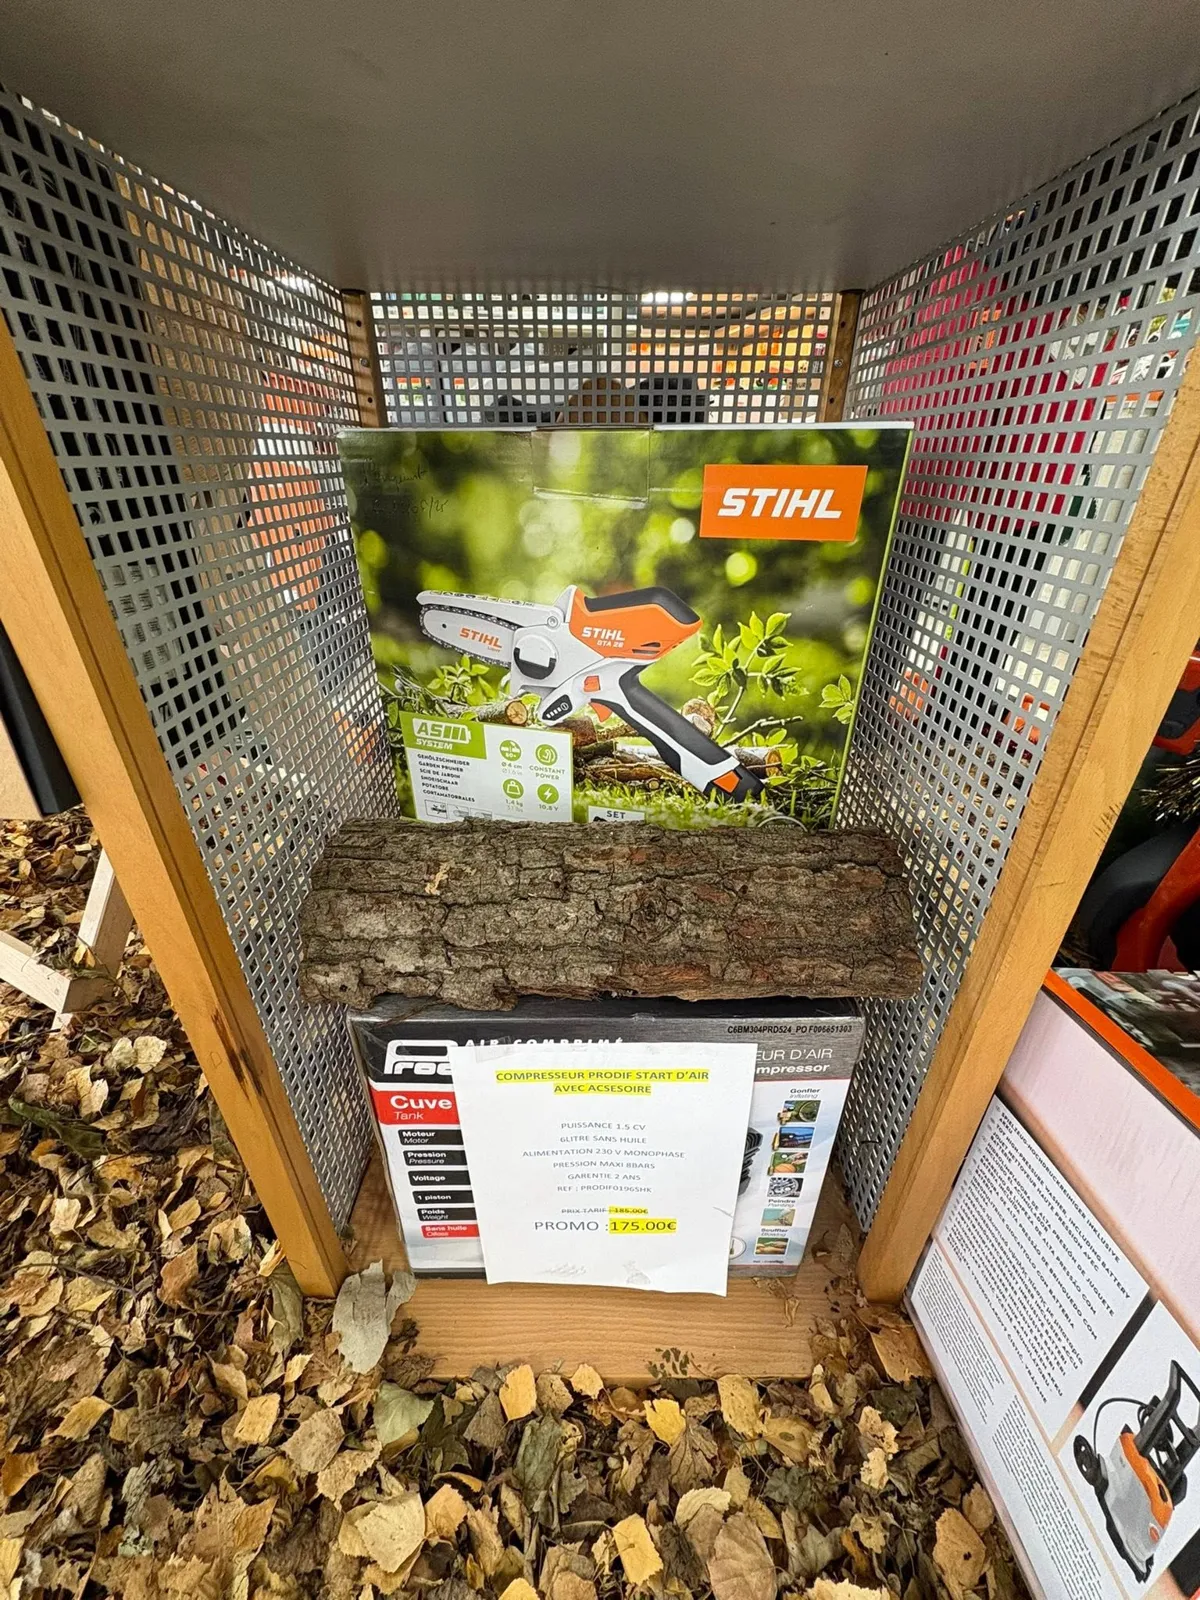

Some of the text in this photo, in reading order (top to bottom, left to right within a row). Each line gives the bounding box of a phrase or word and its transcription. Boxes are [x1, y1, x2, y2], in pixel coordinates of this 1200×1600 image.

[717, 487, 843, 519] STIHL
[459, 627, 503, 649] STIHL
[581, 626, 626, 641] STIHL
[596, 639, 612, 647] GTA
[416, 738, 454, 750] SYSTEM
[417, 754, 470, 766] GEHÖLZSCHNEIDER
[418, 760, 464, 772] GARDEN PRUNER
[528, 765, 566, 774] CONSTANT
[535, 772, 560, 780] POWER
[422, 782, 450, 791] POTATORE
[422, 789, 476, 802] CORTAMATORRALES
[606, 810, 626, 819] SET
[496, 1072, 585, 1081] COMPRESSEUR
[588, 1072, 632, 1080] PRODIF
[635, 1071, 674, 1080] START
[554, 1084, 652, 1094] AVEC ACSESOIRE
[390, 1096, 452, 1110] Cuve
[394, 1112, 424, 1120] Tank
[999, 1116, 1012, 1134] AKKU
[522, 1148, 594, 1157] ALIMENTATION
[624, 1150, 686, 1158] MONOPHASE
[990, 1134, 1011, 1164] BATTERIE
[553, 1160, 596, 1168] PRESSION
[1000, 1110, 1120, 1264] SPIELZEUG-HOCHDRUCKREINIGER INKLUSIVE
[993, 1129, 1099, 1272] JOUET NETTOYEUR HAUTE PRESSION AVEC
[1006, 1175, 1013, 1186] EL
[1013, 1184, 1048, 1233] ACUMULADOR
[995, 1122, 1130, 1301] TOY HIGH-PRESSURE WASHER, INCLUDING BATTERY
[534, 1220, 600, 1231] PROMO
[987, 1140, 1114, 1317] HIDROLIMPIADORA DE ALTA PRESIÓN DE JUGUETE
[1005, 1185, 1013, 1197] DE
[1012, 1195, 1034, 1226] LIMPEZA
[1034, 1225, 1042, 1238] DE
[1041, 1235, 1055, 1256] ALTA
[1055, 1255, 1082, 1293] PRESSÃO
[1080, 1292, 1096, 1315] COM
[999, 1195, 1006, 1207] DE
[1006, 1205, 1018, 1224] ALTA
[1018, 1222, 1041, 1256] PRESSÃO
[1040, 1255, 1049, 1268] DE
[1048, 1266, 1083, 1317] BRINQUEDO
[1082, 1316, 1098, 1340] COM
[1004, 1222, 1036, 1270] GIOCATTOLO
[1048, 1287, 1075, 1329] BATTERIA
[1008, 1292, 1055, 1370] INKLUSIVE BATTERI
[1018, 1285, 1045, 1328] INKLUSIVE
[1044, 1327, 1068, 1365] BATTERI
[1017, 1295, 1066, 1376] INKLUSIVE BATTERI
[1034, 1299, 1062, 1344] INCLUSIEF
[1061, 1343, 1078, 1370] ACCU
[1006, 1301, 1028, 1337] MUKAAN
[1047, 1369, 1063, 1396] AKKU
